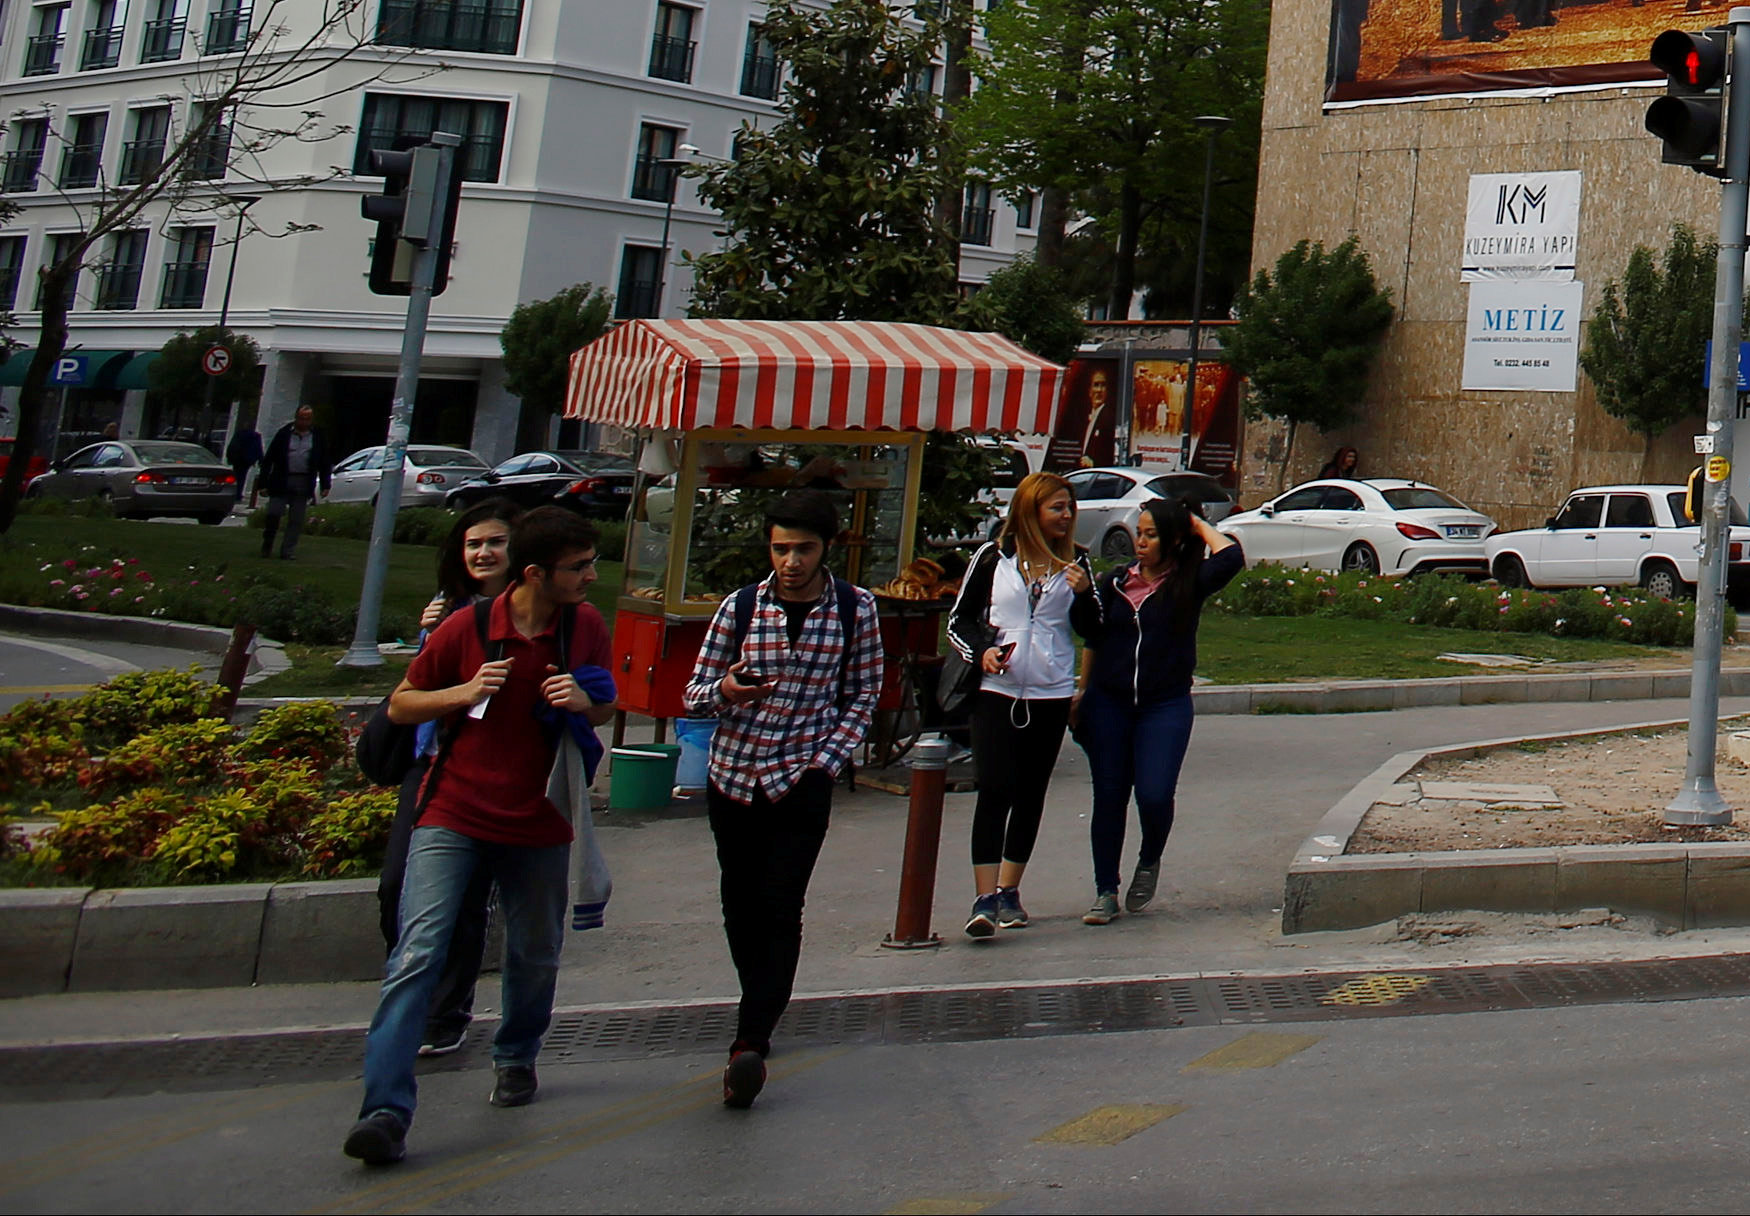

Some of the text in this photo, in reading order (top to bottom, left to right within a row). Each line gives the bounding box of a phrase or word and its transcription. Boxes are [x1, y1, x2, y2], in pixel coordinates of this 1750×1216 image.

[1496, 184, 1548, 225] KM
[1466, 232, 1574, 256] KUZEYMİRA YAPI
[1482, 304, 1566, 332] METİZ
[56, 358, 79, 380] P
